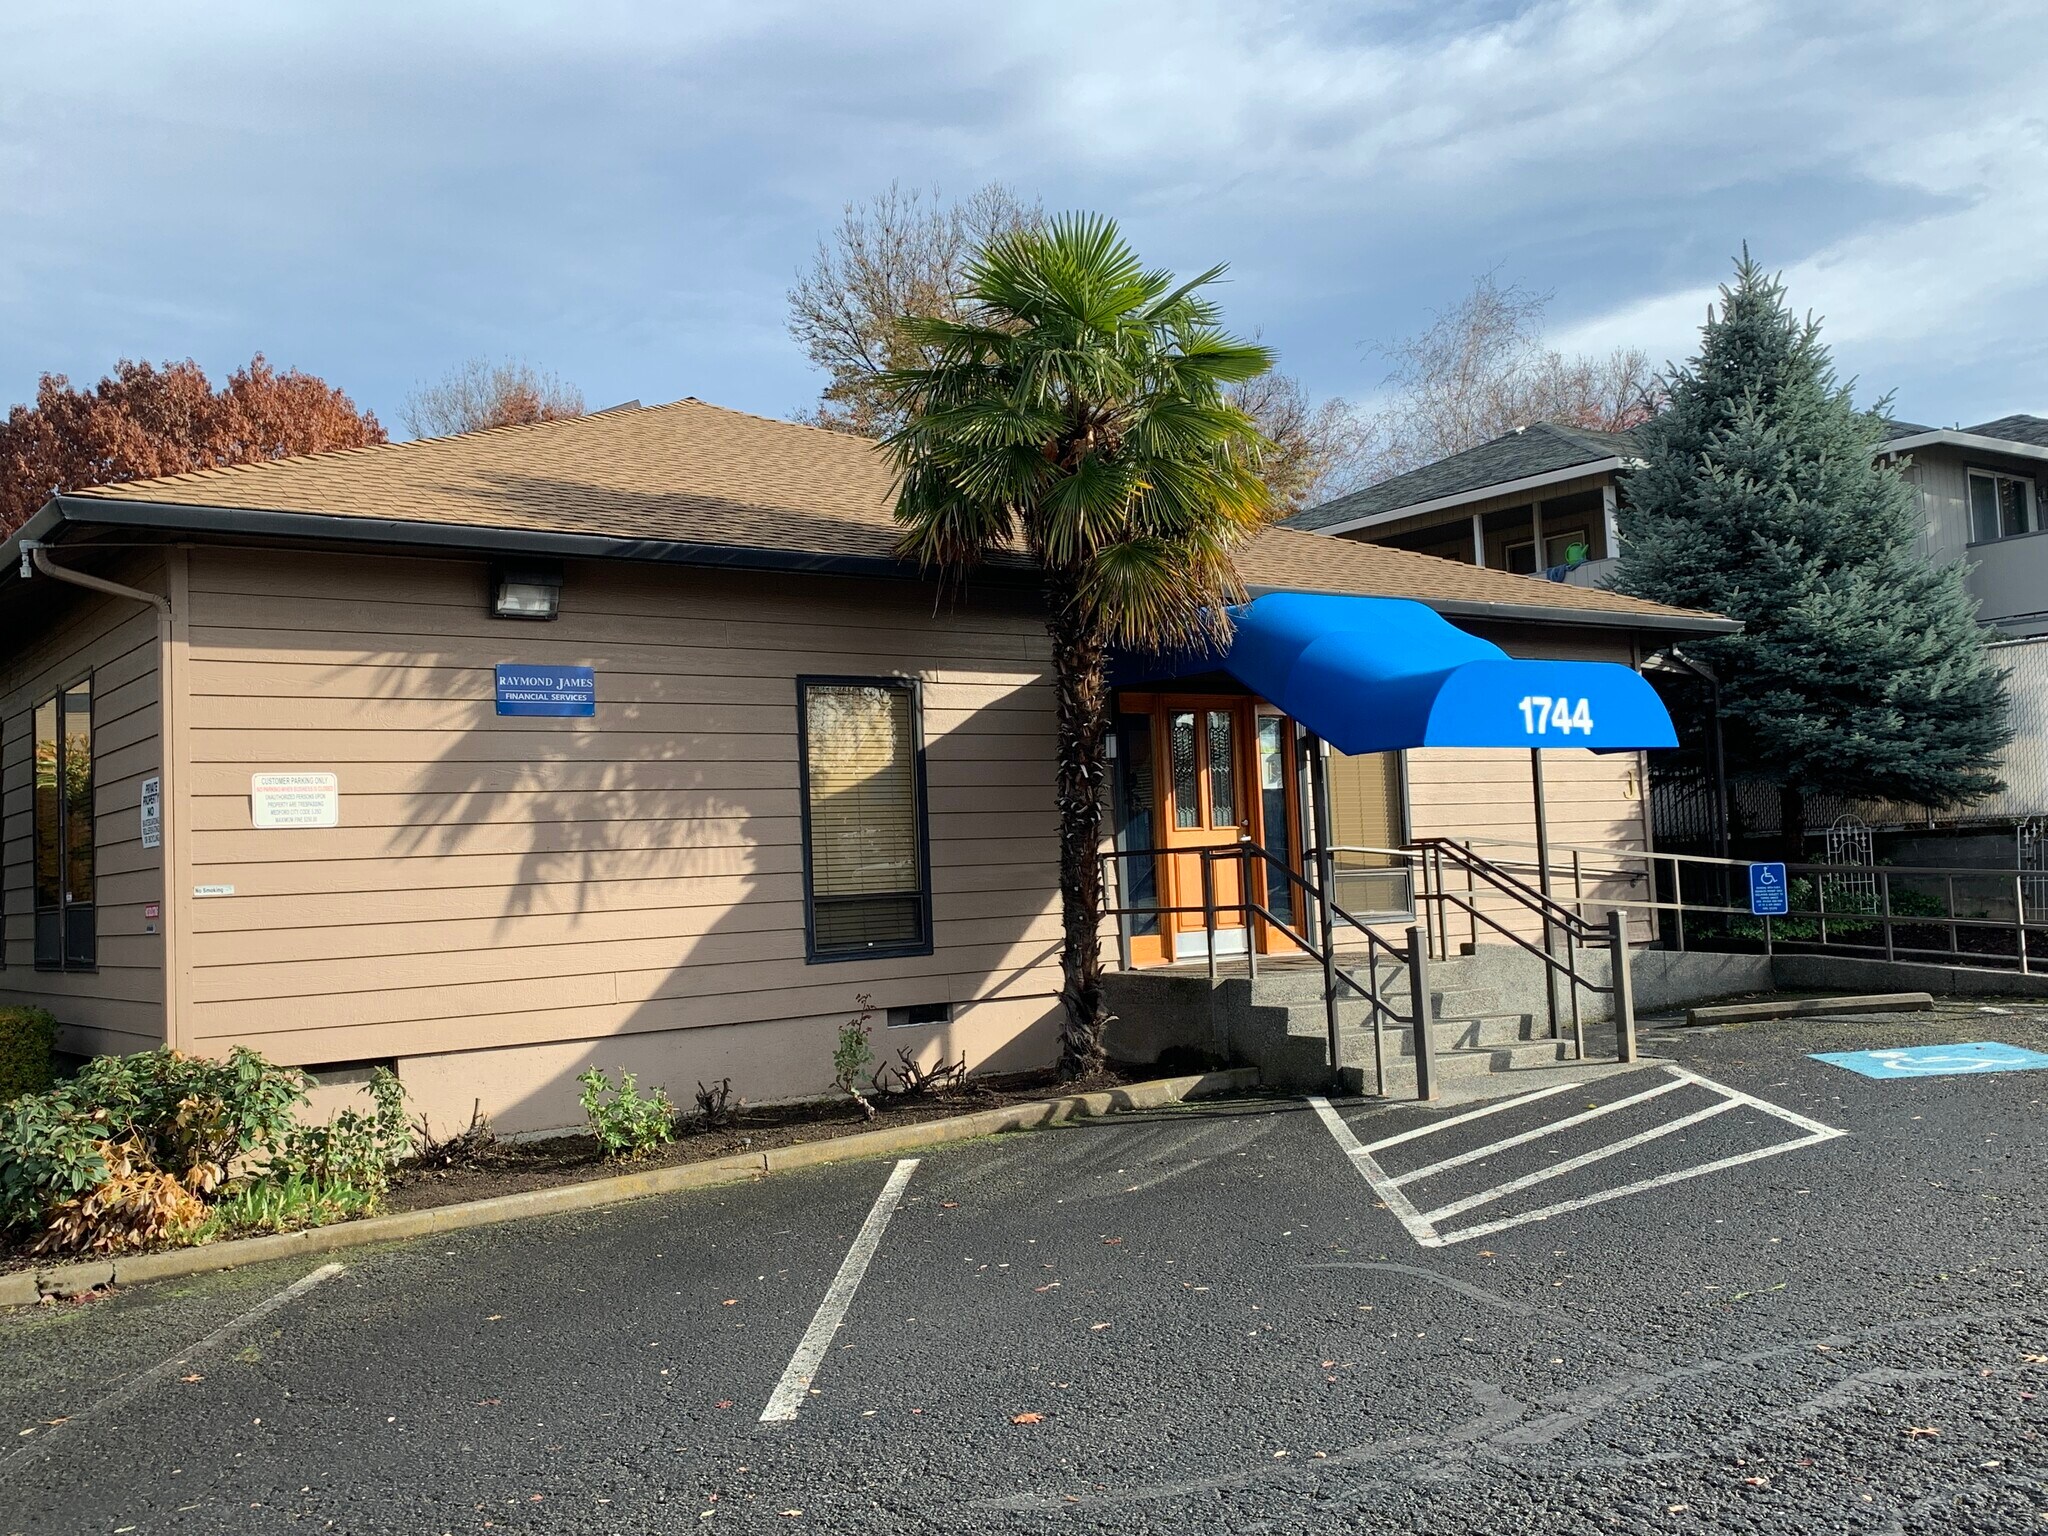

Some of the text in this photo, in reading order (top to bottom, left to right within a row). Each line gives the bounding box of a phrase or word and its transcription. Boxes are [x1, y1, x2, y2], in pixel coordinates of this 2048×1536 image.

[499, 676, 593, 690] RAYMOND JAMES
[505, 692, 587, 701] FINANCIAL SERVICES
[1519, 696, 1594, 735] 1744
[261, 777, 290, 785] CUSTOMER
[291, 777, 313, 785] PARKING
[147, 806, 155, 816] NO
